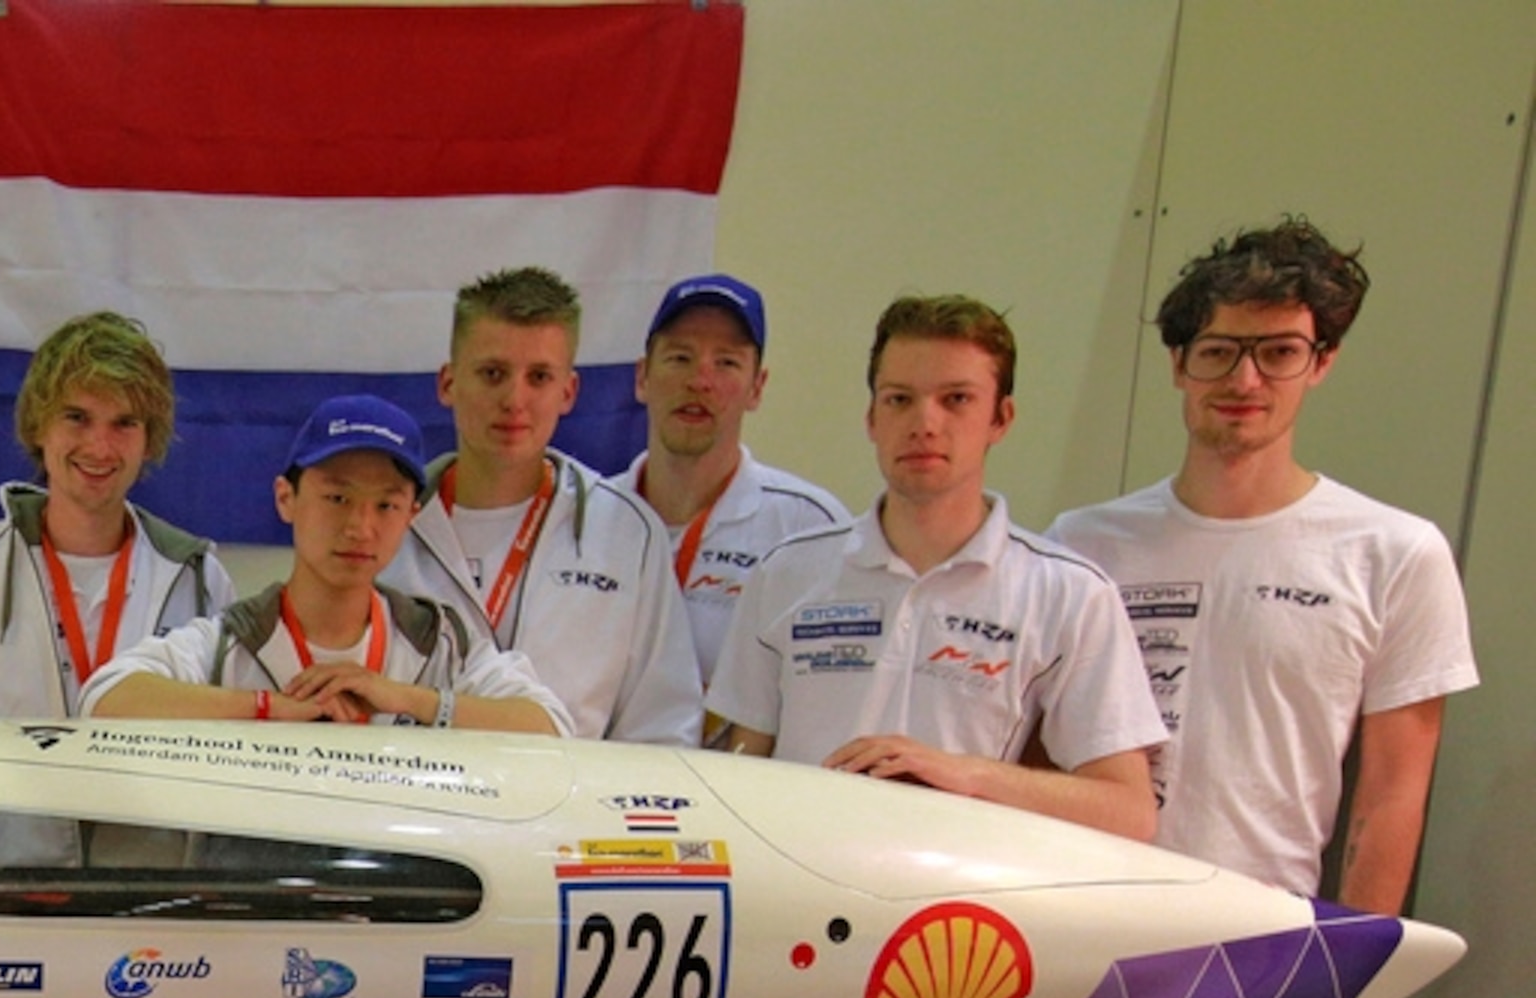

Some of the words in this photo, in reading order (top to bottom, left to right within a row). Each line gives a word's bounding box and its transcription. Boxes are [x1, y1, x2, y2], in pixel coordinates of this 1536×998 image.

[86, 744, 200, 763] Amsterdam
[205, 752, 304, 776] University
[308, 763, 330, 776] of
[90, 730, 243, 750] Hogeschool
[252, 742, 299, 756] van
[307, 746, 466, 774] Amsterdam
[128, 956, 211, 979] anwb
